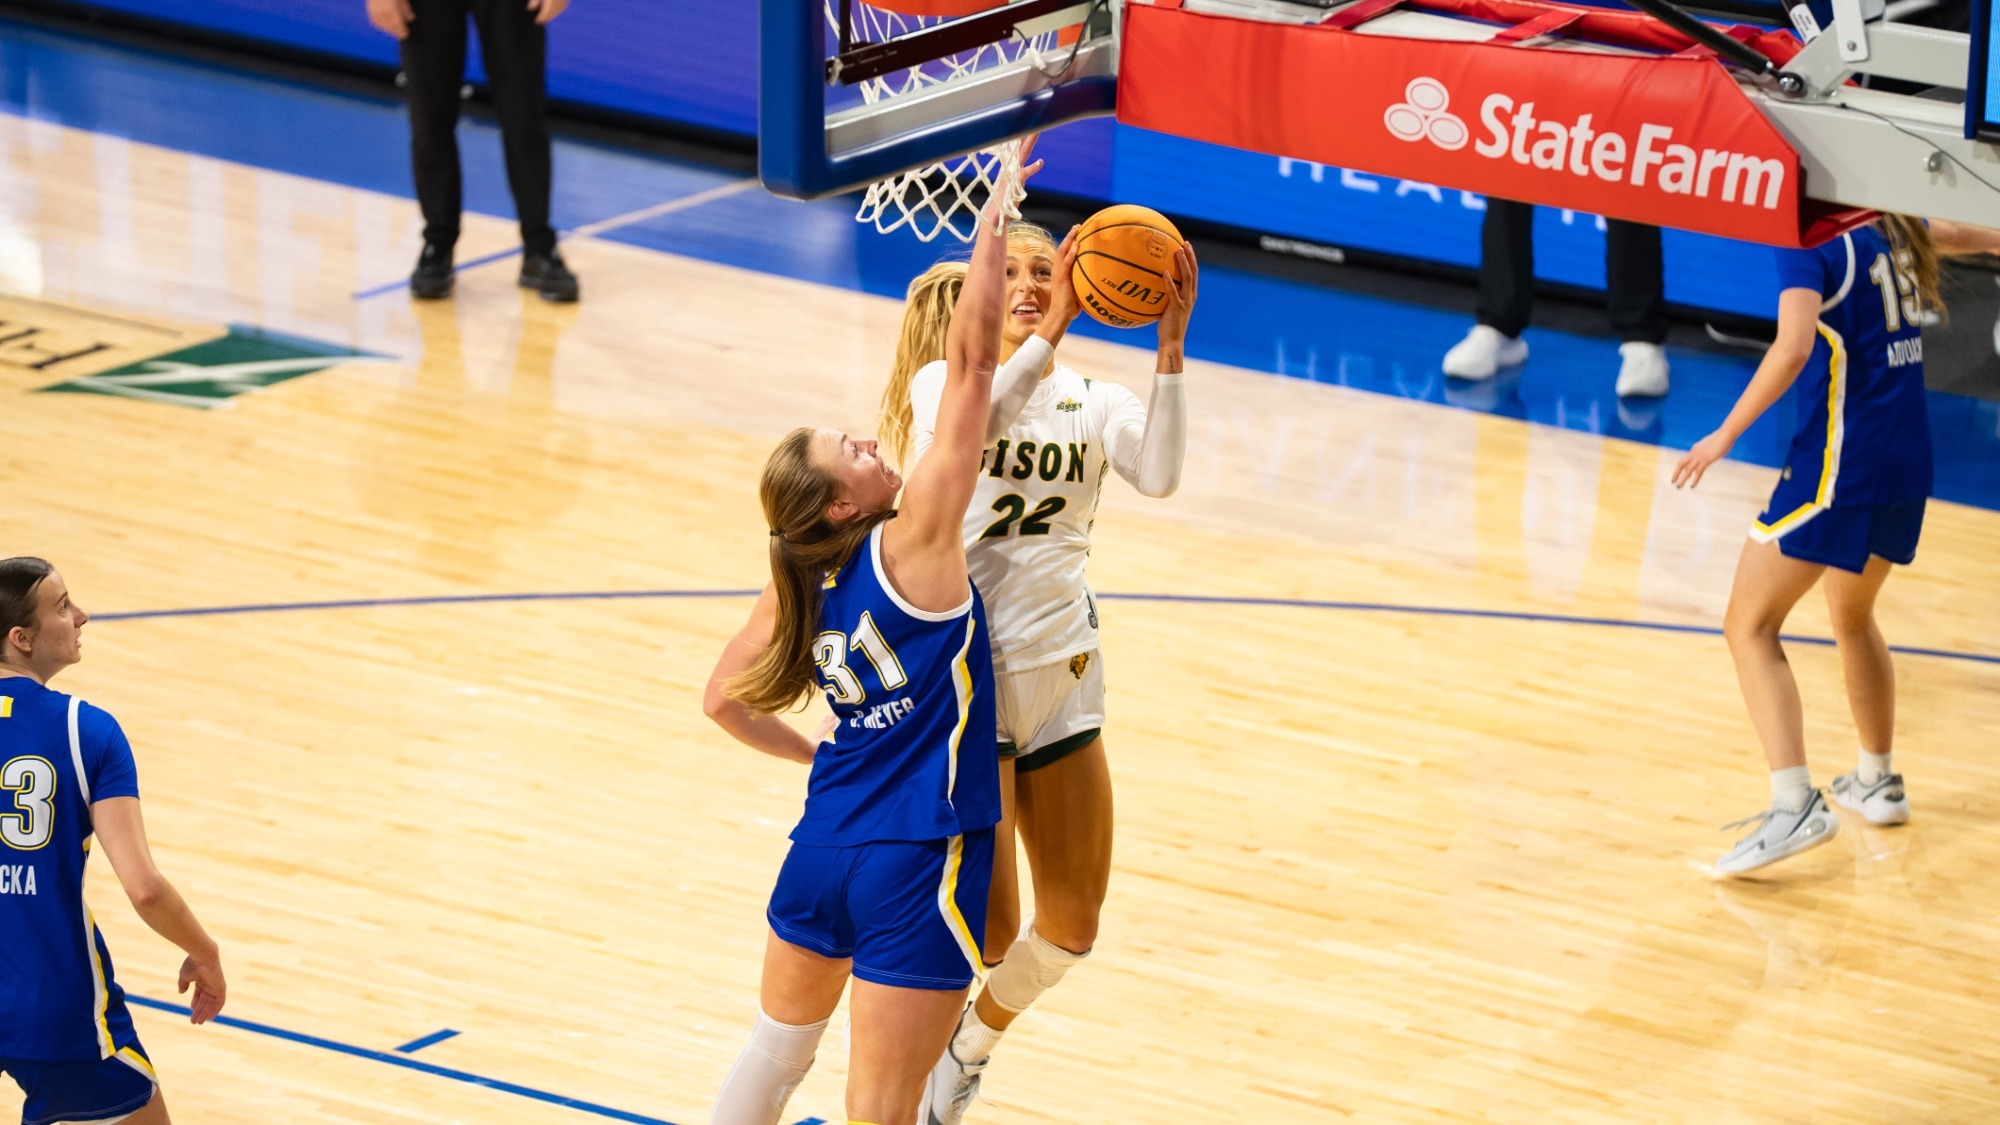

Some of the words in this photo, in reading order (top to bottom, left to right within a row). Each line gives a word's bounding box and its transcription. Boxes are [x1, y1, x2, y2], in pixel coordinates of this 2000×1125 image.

[1869, 247, 1921, 332] 15
[978, 493, 1067, 541] 22
[812, 610, 908, 706] 31
